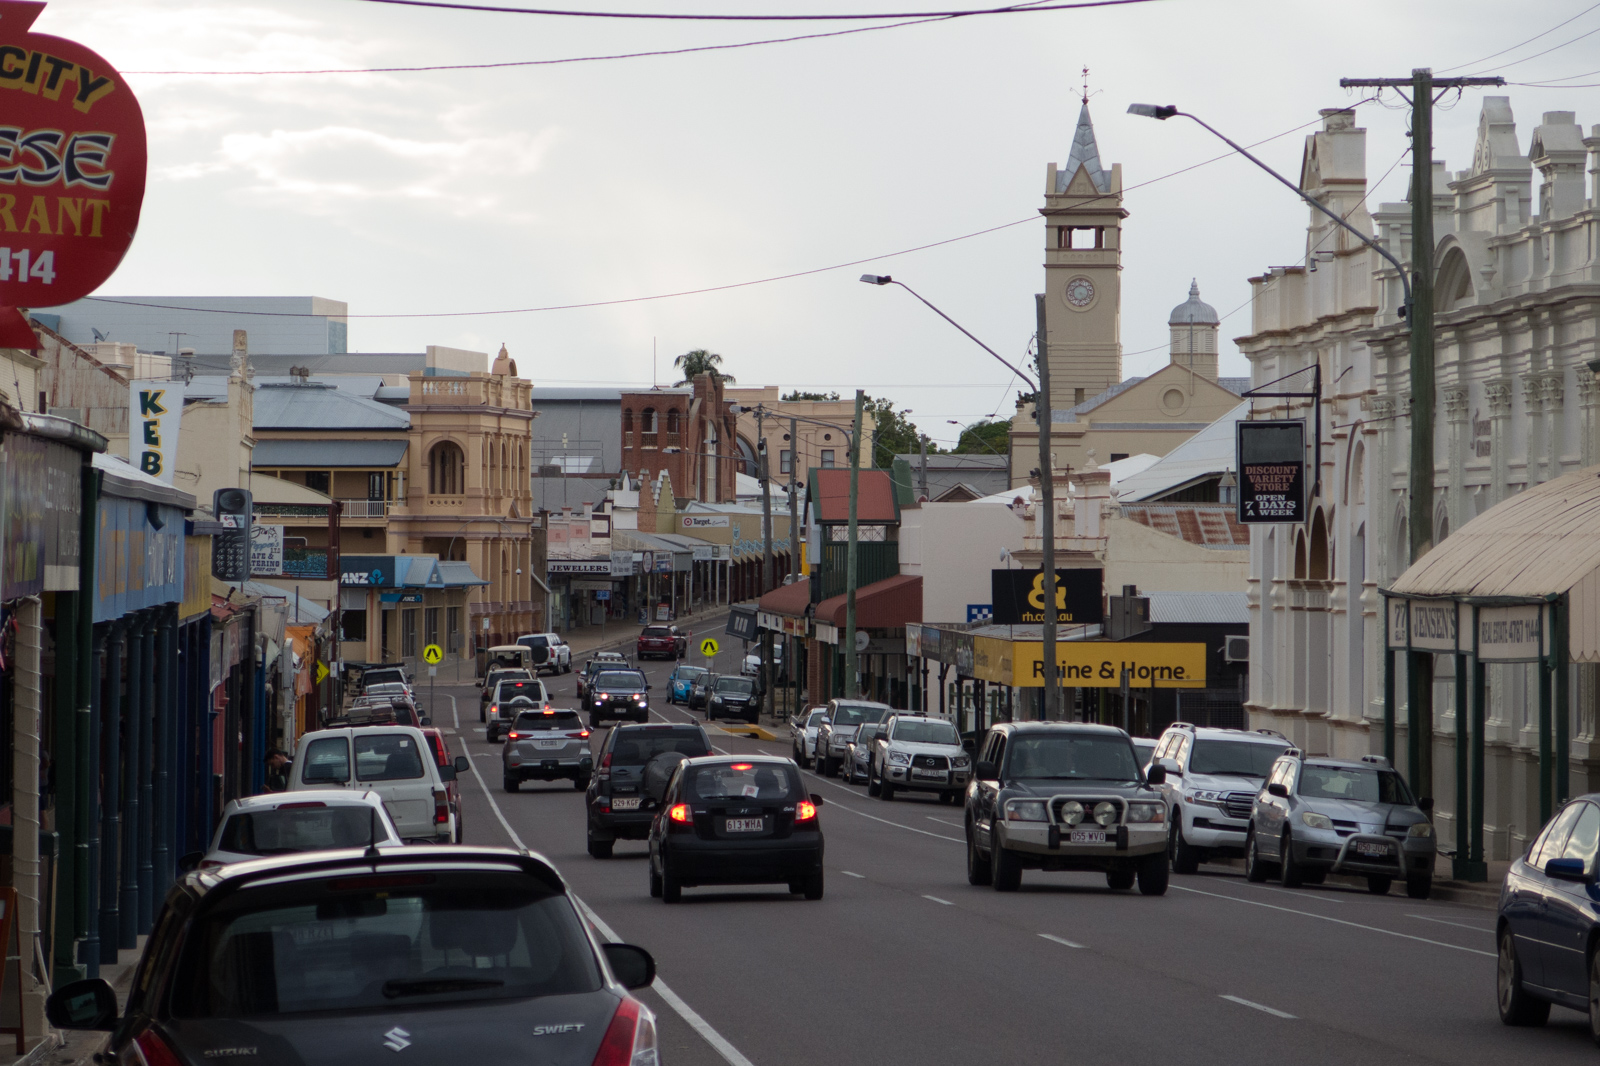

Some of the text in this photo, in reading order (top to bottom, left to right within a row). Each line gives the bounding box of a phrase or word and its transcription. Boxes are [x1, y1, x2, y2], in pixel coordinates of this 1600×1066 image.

[0, 45, 114, 113] CITY
[1245, 465, 1298, 475] DISCOUNT
[1248, 474, 1295, 483] VARIETY
[1254, 483, 1290, 491] STORE
[1245, 501, 1296, 509] 7 DAYS
[341, 572, 369, 584] ANZ
[1022, 611, 1073, 622] rh.c.au
[1394, 603, 1407, 628] 77
[1414, 607, 1456, 639] JENSEN'S
[1033, 660, 1093, 679] Rine
[1099, 660, 1115, 679] &
[1121, 661, 1185, 679] Horne
[532, 1023, 585, 1036] SWIFT
